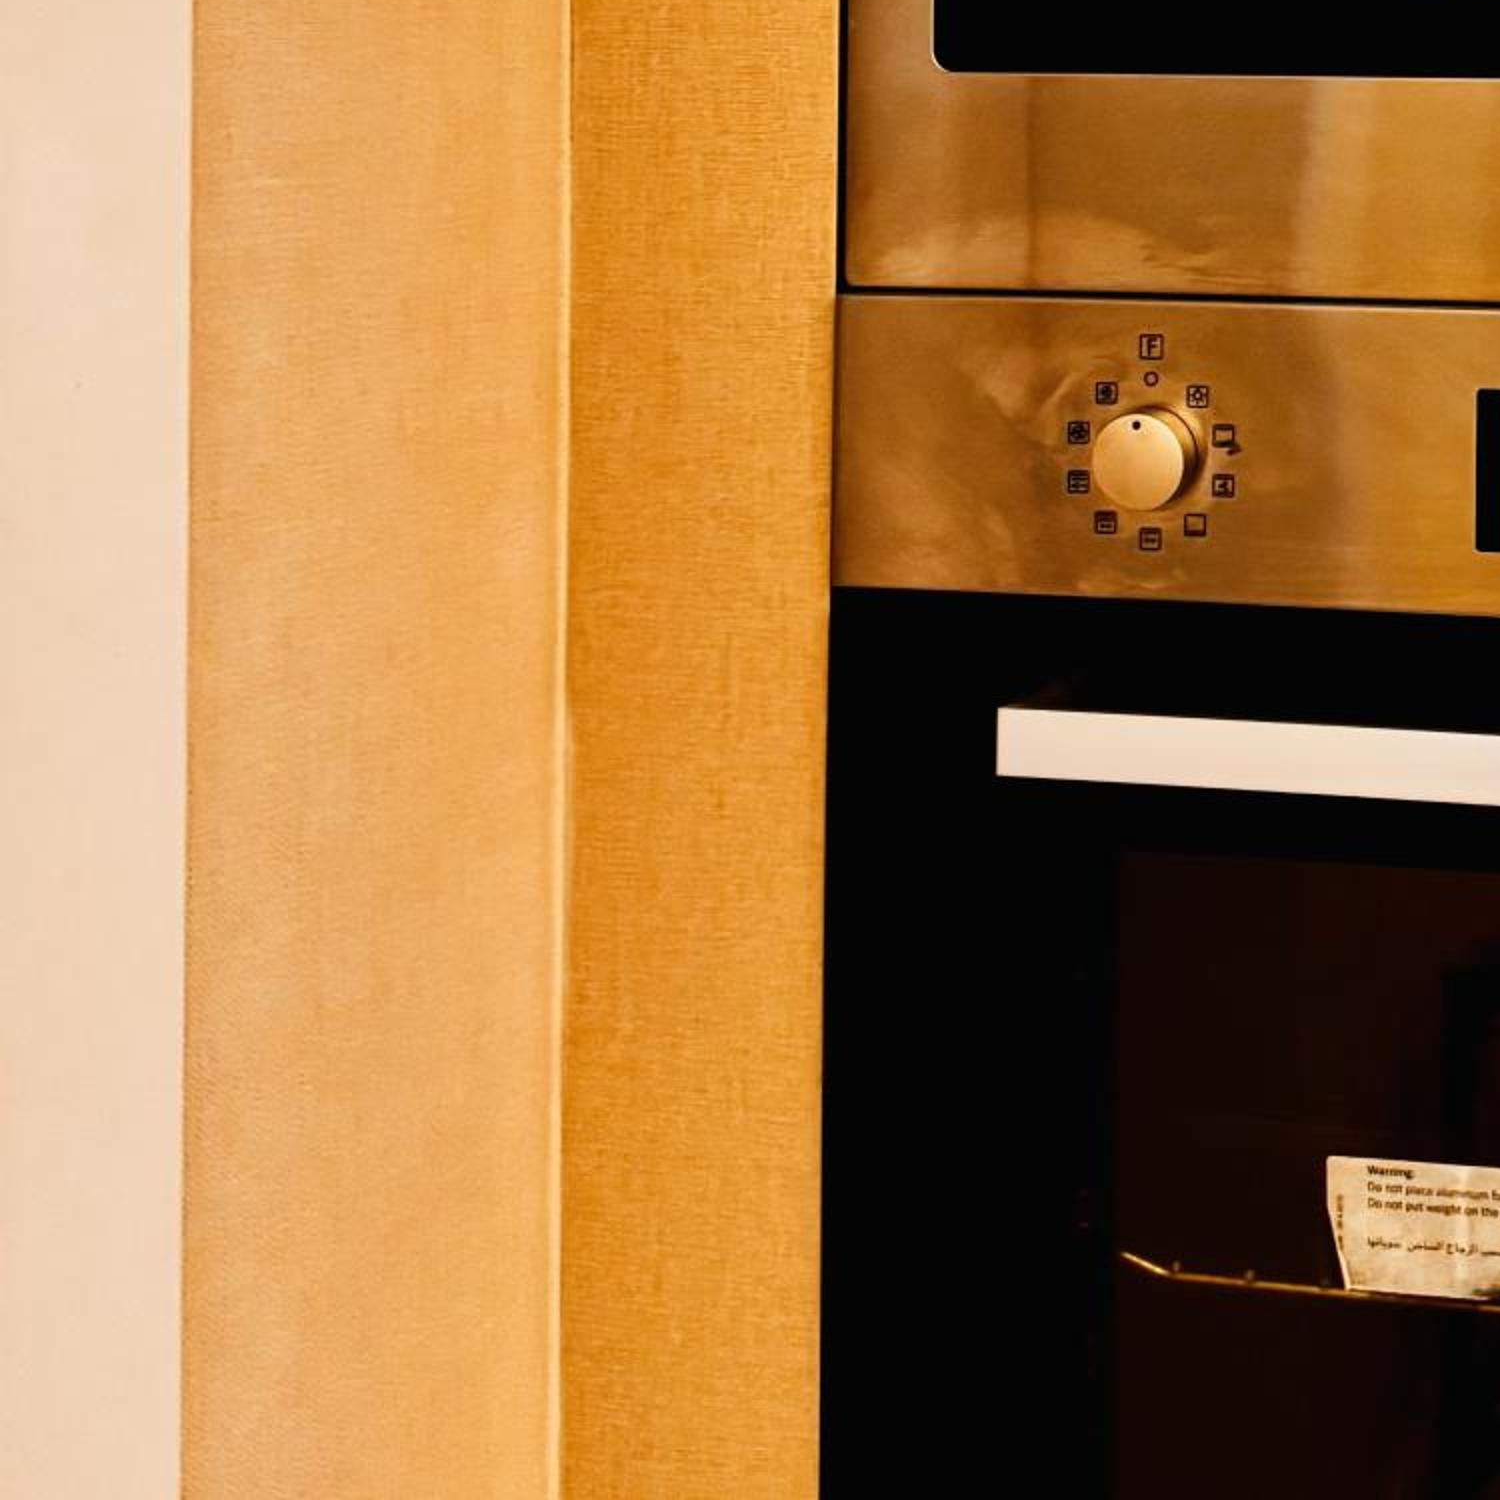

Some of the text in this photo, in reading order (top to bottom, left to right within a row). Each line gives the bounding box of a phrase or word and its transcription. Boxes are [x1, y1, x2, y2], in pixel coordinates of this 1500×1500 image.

[1367, 1181, 1382, 1193] Do
[1385, 1183, 1403, 1194] not
[1367, 1198, 1382, 1208] Do
[1385, 1199, 1403, 1210] not
[1405, 1201, 1424, 1213] put
[1464, 1206, 1479, 1216] on
[1481, 1206, 1499, 1217] the
